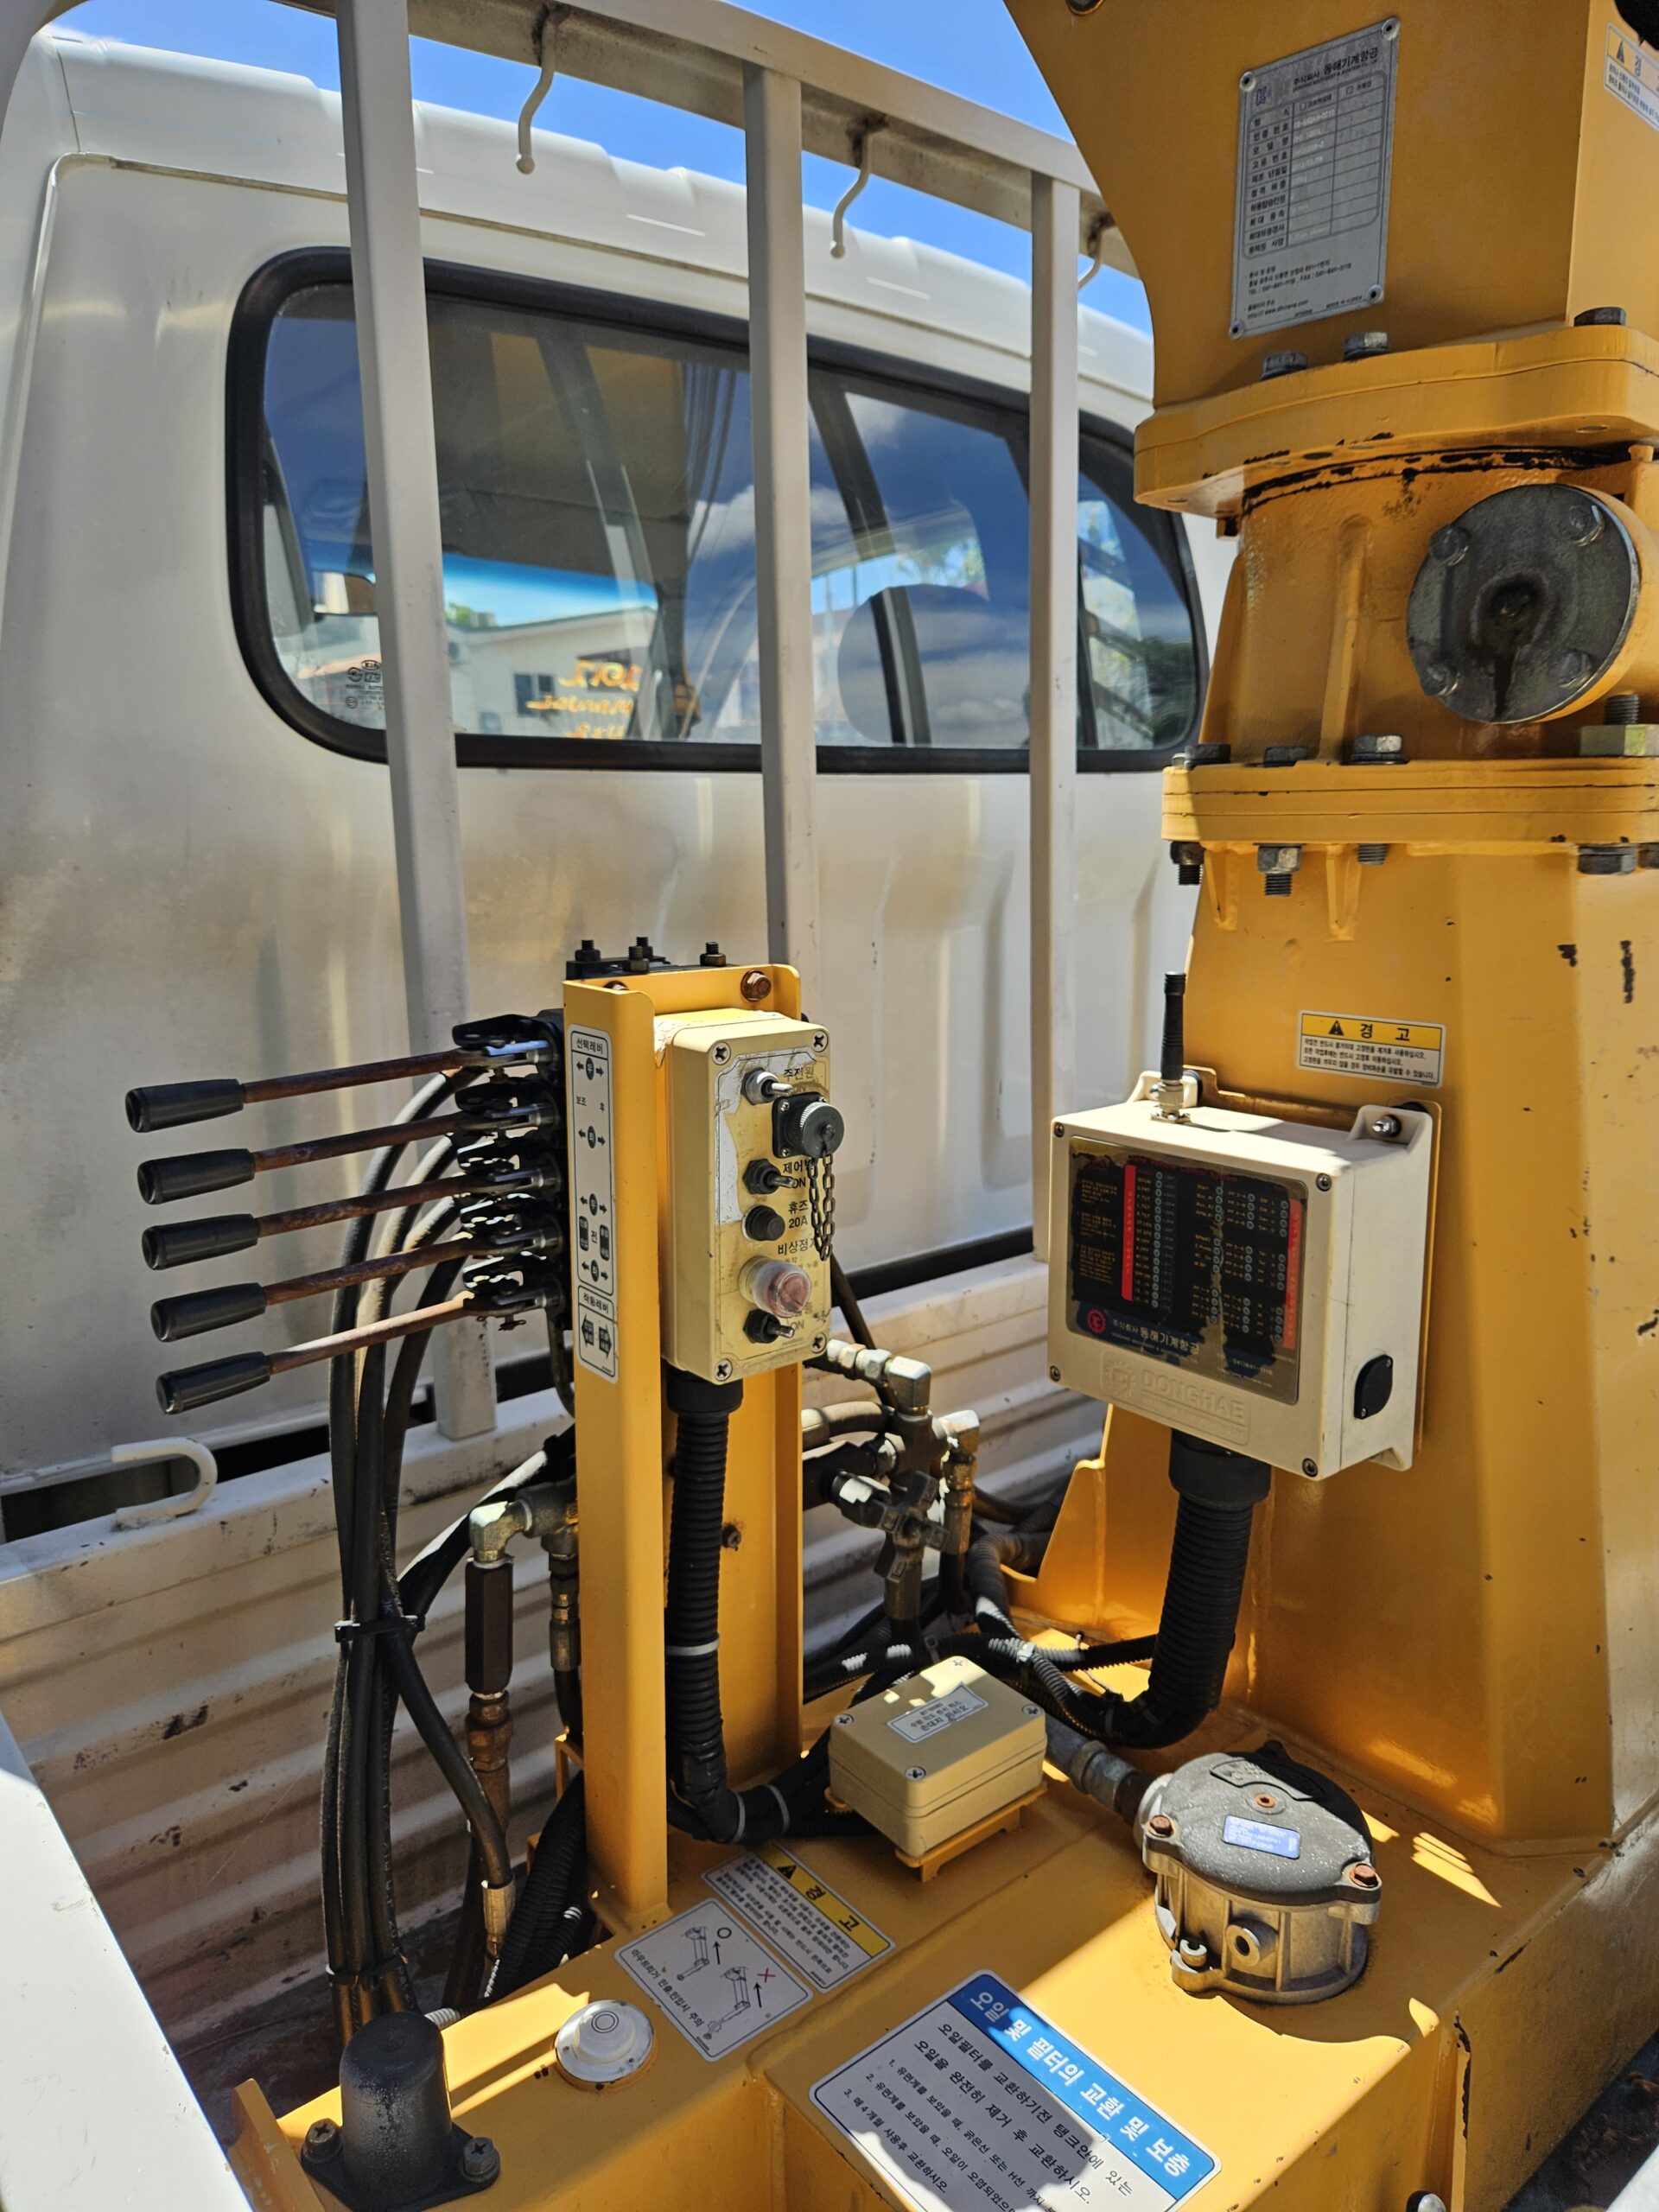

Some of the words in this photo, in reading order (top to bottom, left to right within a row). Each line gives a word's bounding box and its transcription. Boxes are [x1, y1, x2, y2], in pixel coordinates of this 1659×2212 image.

[1323, 45, 1378, 75] 동해기계항공
[576, 1038, 604, 1055] 선택레버
[1359, 1023, 1373, 1039] 경
[1395, 1027, 1410, 1041] 고
[783, 1066, 815, 1082] 주전원
[788, 1199, 809, 1215] 휴즈
[789, 1215, 808, 1230] 20A
[583, 1292, 608, 1313] 작동레버
[1140, 1326, 1199, 1356] 동해기계항공
[1141, 1369, 1245, 1420] DONGHAE
[805, 1885, 826, 1901] 경
[838, 1914, 860, 1932] 고
[631, 1948, 661, 1980] 아우트리거
[688, 2012, 704, 2028] 주의
[969, 1992, 1009, 2023] 오일
[1004, 2018, 1033, 2042] 및
[1027, 2037, 1084, 2087] 필터의
[1079, 2082, 1125, 2120] 교환
[1120, 2116, 1149, 2142] 및
[1145, 2138, 1191, 2177] 보충
[914, 2040, 950, 2071] 오일을
[949, 2071, 986, 2103] 완전히
[985, 2103, 1013, 2127] 제거
[1013, 2128, 1027, 2142] 후
[1028, 2144, 1090, 2204] 교환하시오.
[938, 2024, 994, 2071] 오일필터를
[993, 2071, 1052, 2124] 교환하기전
[1052, 2123, 1104, 2170] 탱크안에
[1105, 2170, 1133, 2196] 있는
[843, 2088, 853, 2098] 3.
[884, 2127, 908, 2152] 사용후
[907, 2151, 948, 2194] 교환하시오.
[866, 2073, 874, 2082] 2.
[874, 2082, 906, 2111] 유면계를
[905, 2111, 931, 2134] 보았을
[929, 2133, 942, 2147] 때,
[941, 2146, 969, 2171] 오일이
[967, 2171, 1016, 2212] 오염되었으
[896, 2066, 927, 2096] 유면계를
[926, 2094, 952, 2119] 보았을
[951, 2117, 963, 2131] 때,
[989, 2153, 1008, 2172] 또는
[1007, 2171, 1026, 2188] H선
[1026, 2187, 1045, 2206] 까지
